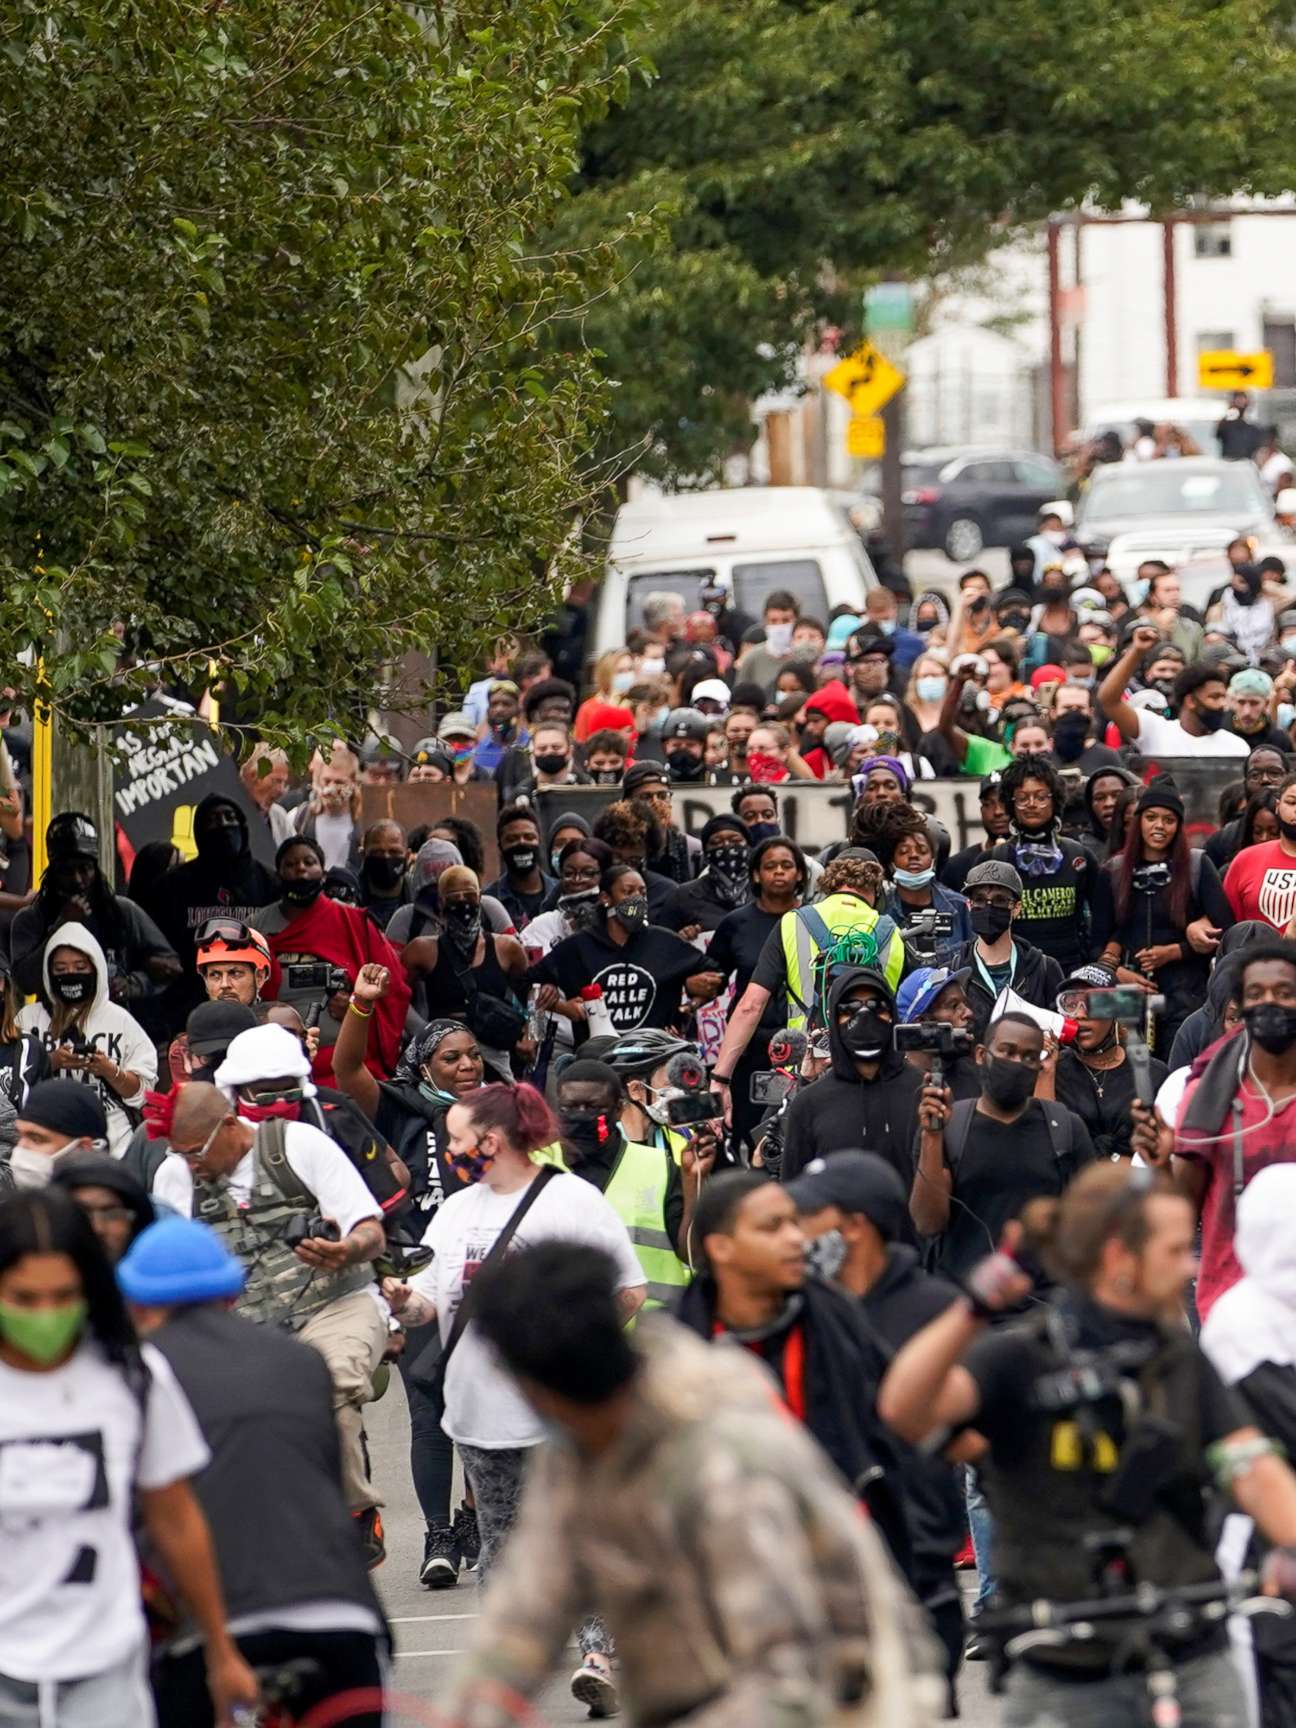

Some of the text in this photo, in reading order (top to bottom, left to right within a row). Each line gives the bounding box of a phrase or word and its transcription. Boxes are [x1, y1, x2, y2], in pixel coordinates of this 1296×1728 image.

[115, 739, 219, 816] IMPORTAN
[607, 973, 638, 987] RED
[608, 1006, 643, 1022] TALK
[43, 1031, 123, 1064] BCK
